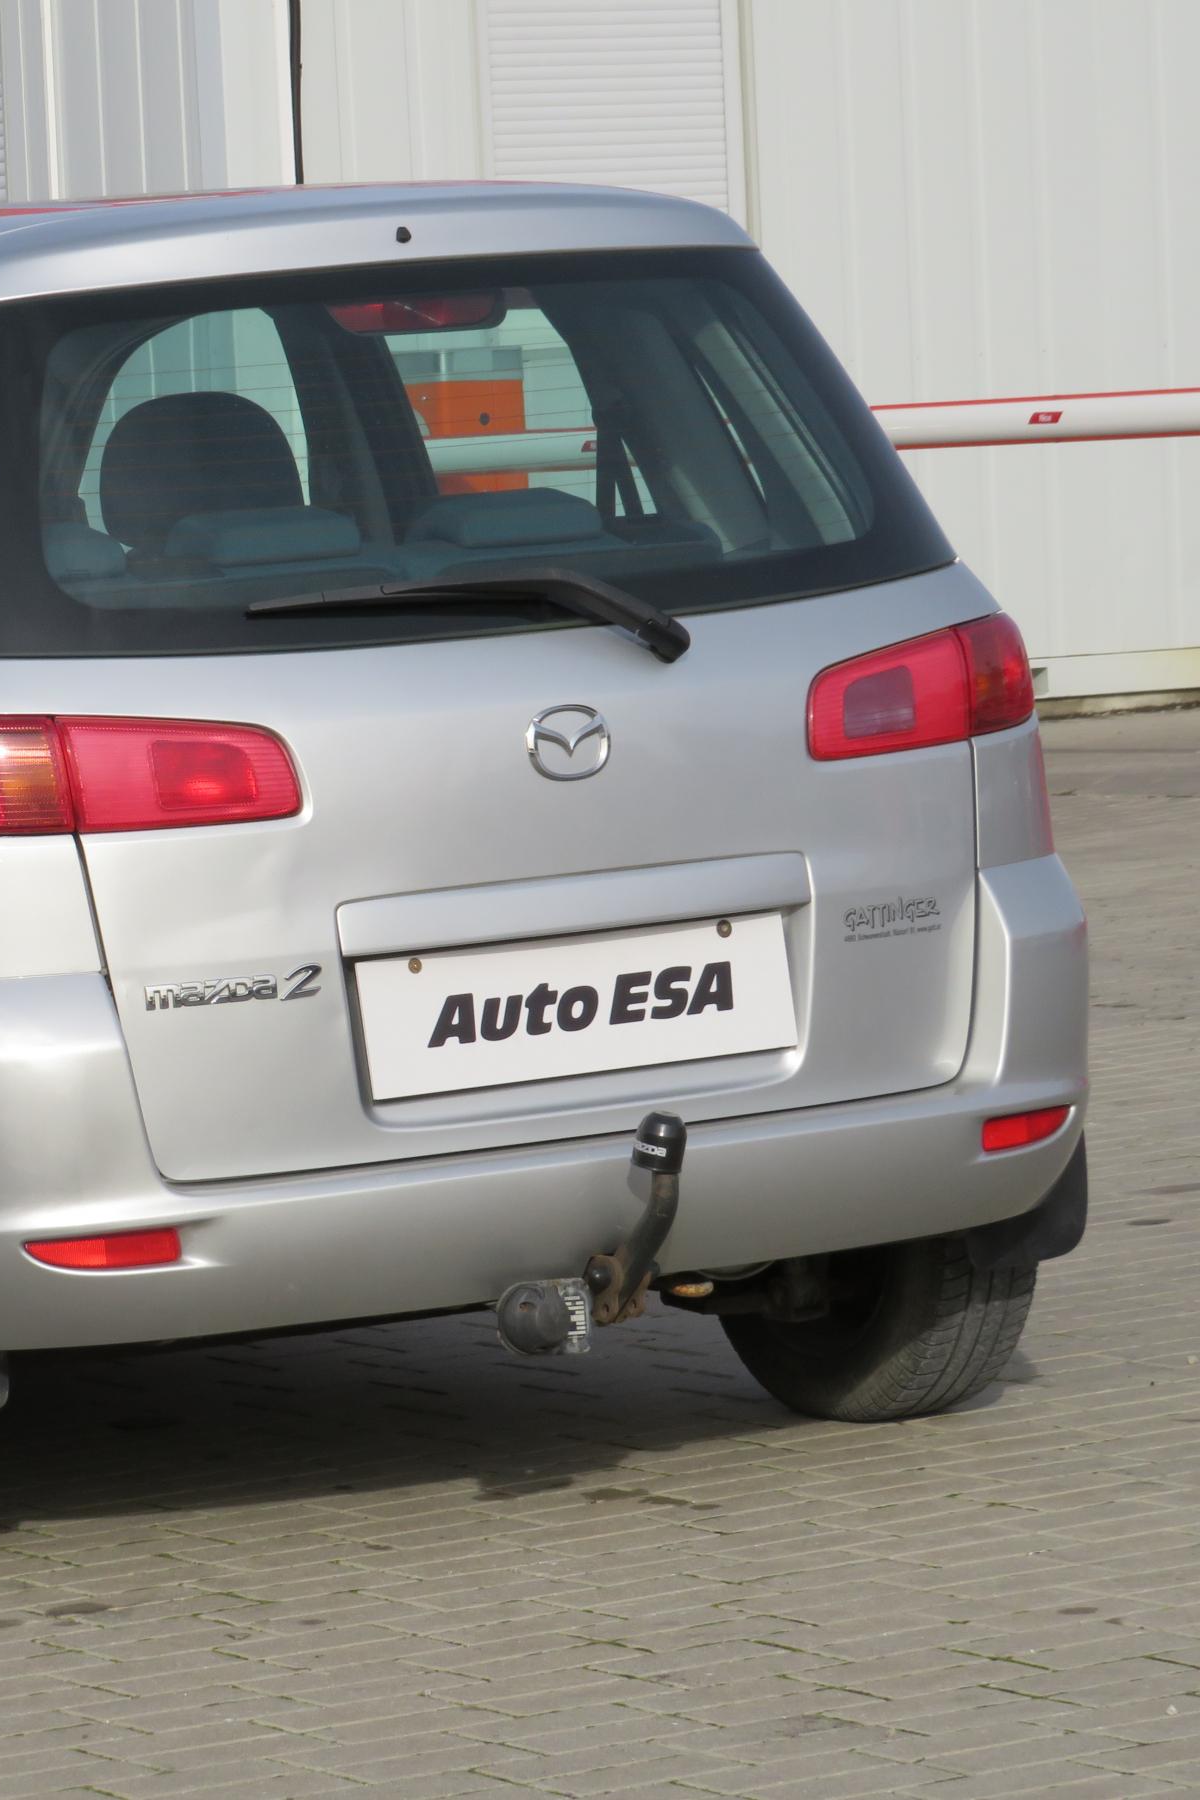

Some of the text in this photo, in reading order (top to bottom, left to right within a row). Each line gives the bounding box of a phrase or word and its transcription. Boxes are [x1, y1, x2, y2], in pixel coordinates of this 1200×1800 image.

[843, 896, 940, 932] GATTINGER
[279, 962, 322, 1001] 2
[427, 961, 734, 1048] Auto ESA
